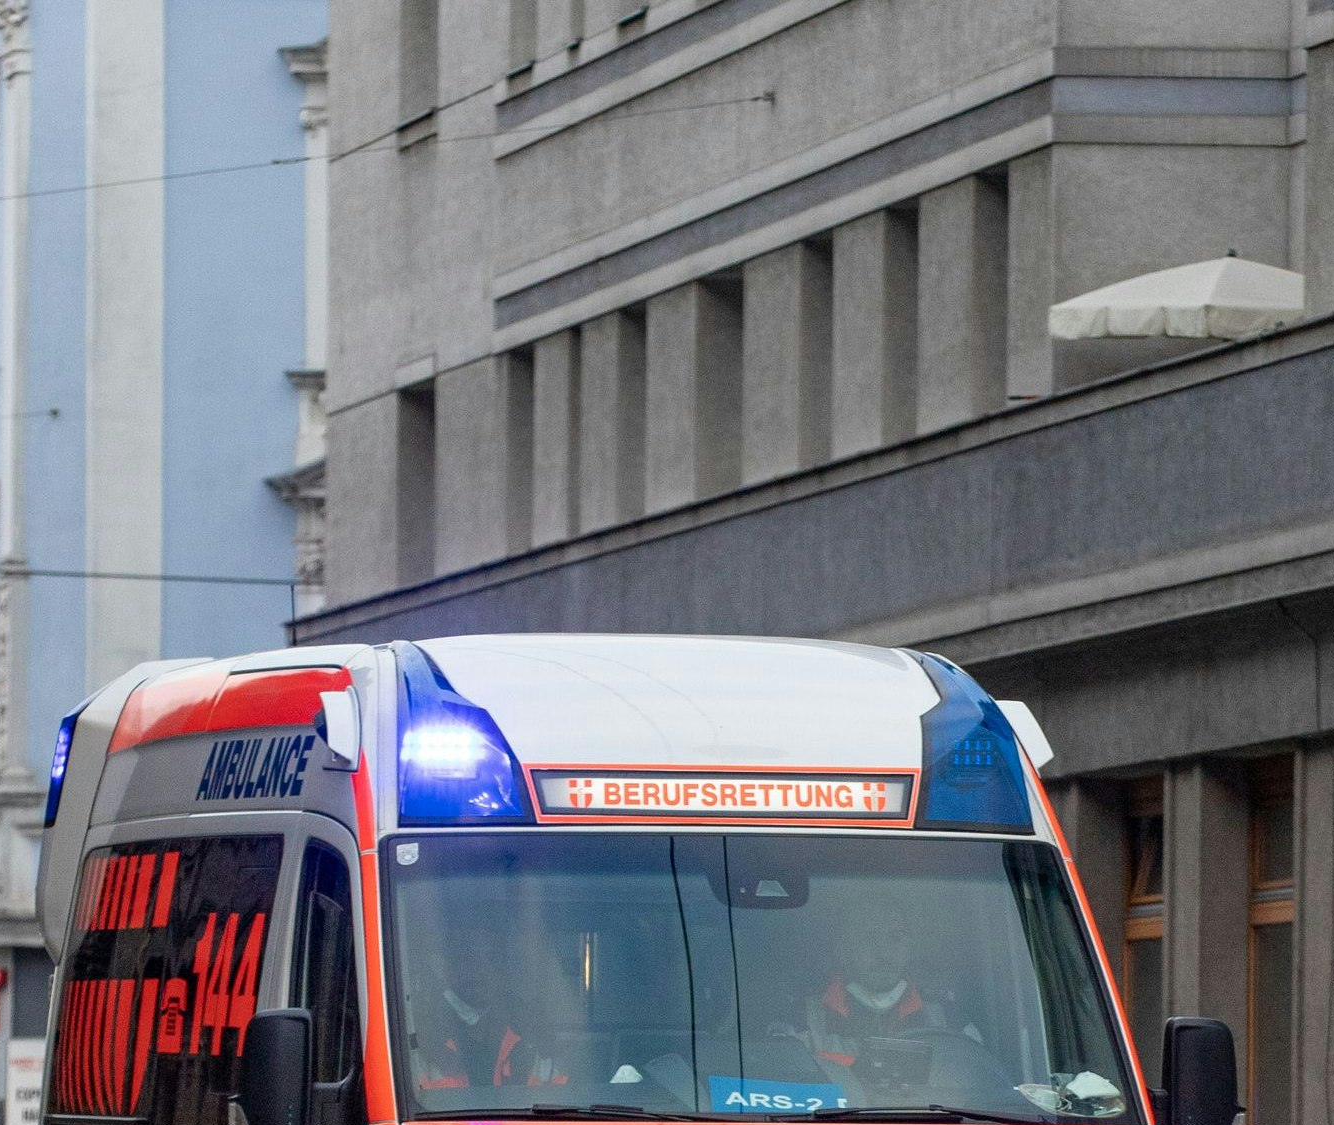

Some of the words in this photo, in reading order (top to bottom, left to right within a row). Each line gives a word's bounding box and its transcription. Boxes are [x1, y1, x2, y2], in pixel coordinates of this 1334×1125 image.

[195, 735, 316, 801] AMBULANCE
[603, 783, 853, 808] BERUFSRETTUNG
[190, 912, 265, 1057] 144
[725, 1091, 823, 1111] ARS-2
